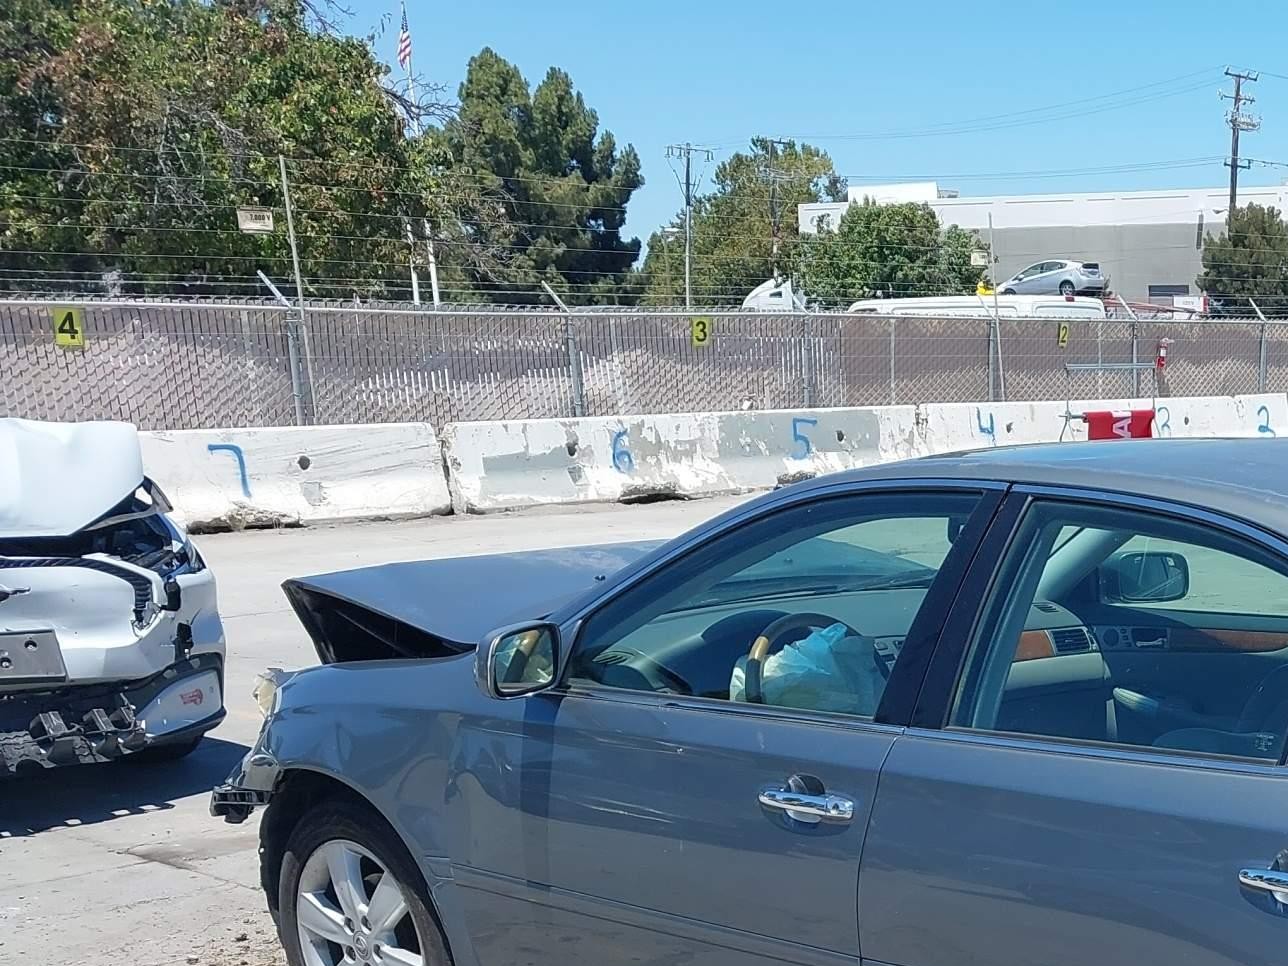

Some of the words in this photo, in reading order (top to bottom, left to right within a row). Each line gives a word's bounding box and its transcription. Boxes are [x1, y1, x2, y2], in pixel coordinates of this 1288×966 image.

[58, 311, 79, 334] 4
[695, 320, 707, 343] 3
[1060, 325, 1068, 343] 2
[976, 407, 995, 441] 4
[1257, 405, 1276, 437] 2
[612, 428, 634, 473] 6
[792, 418, 818, 461] 5
[207, 443, 251, 499] 7
